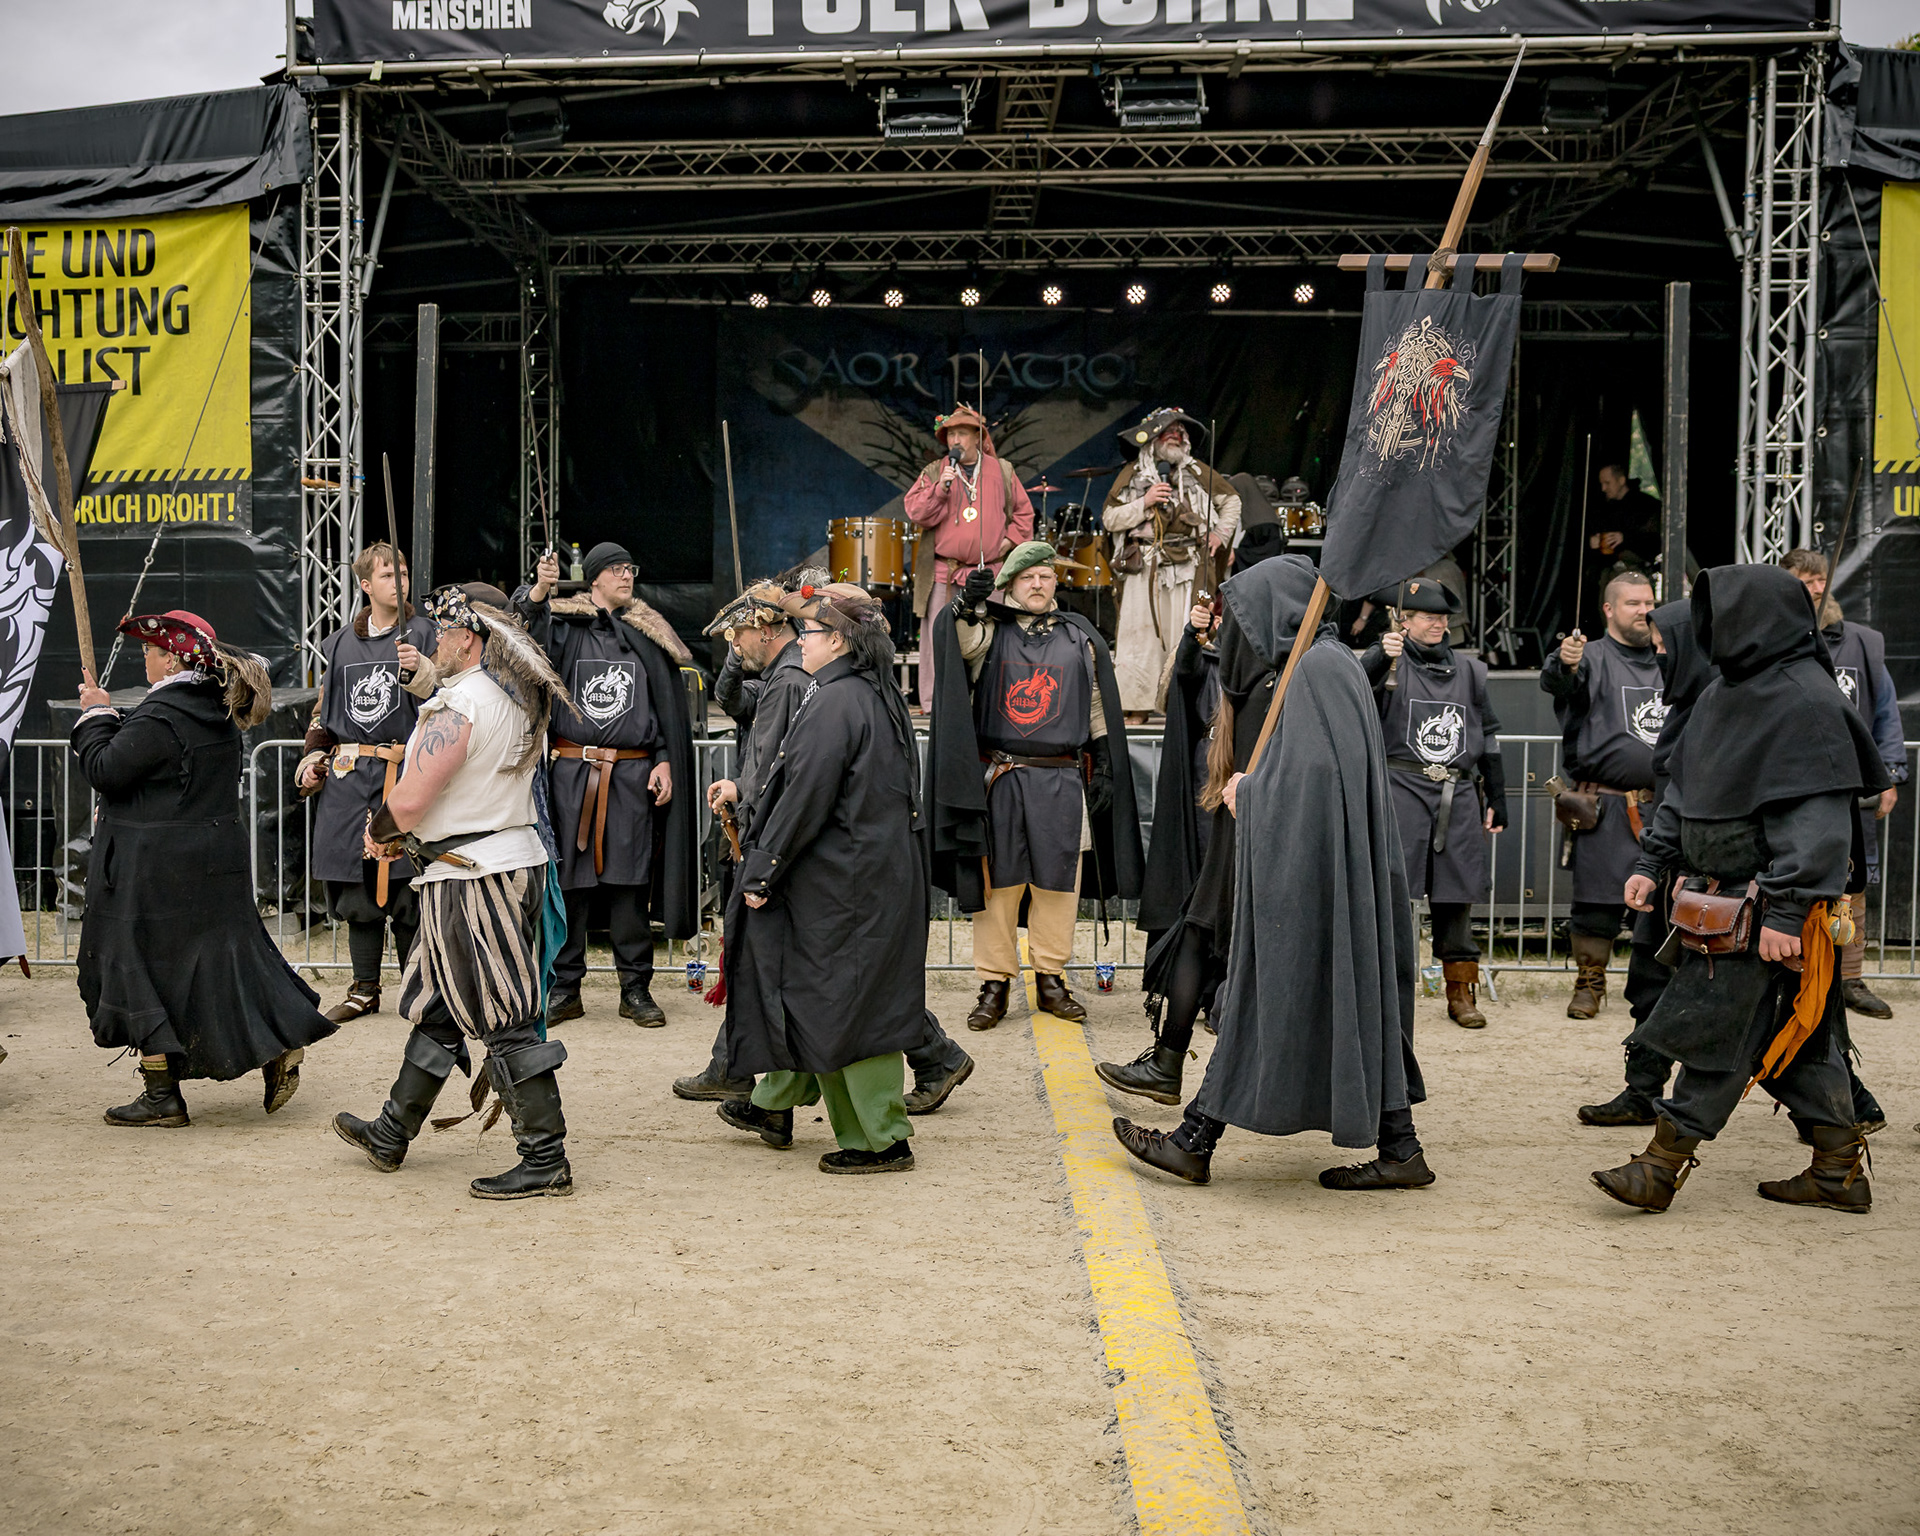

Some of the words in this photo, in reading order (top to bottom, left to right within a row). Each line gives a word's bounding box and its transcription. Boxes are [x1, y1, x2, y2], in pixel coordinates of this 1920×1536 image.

[392, 0, 532, 30] MENSCHEN
[62, 229, 156, 278] UND
[0, 284, 190, 338] CHTUNG
